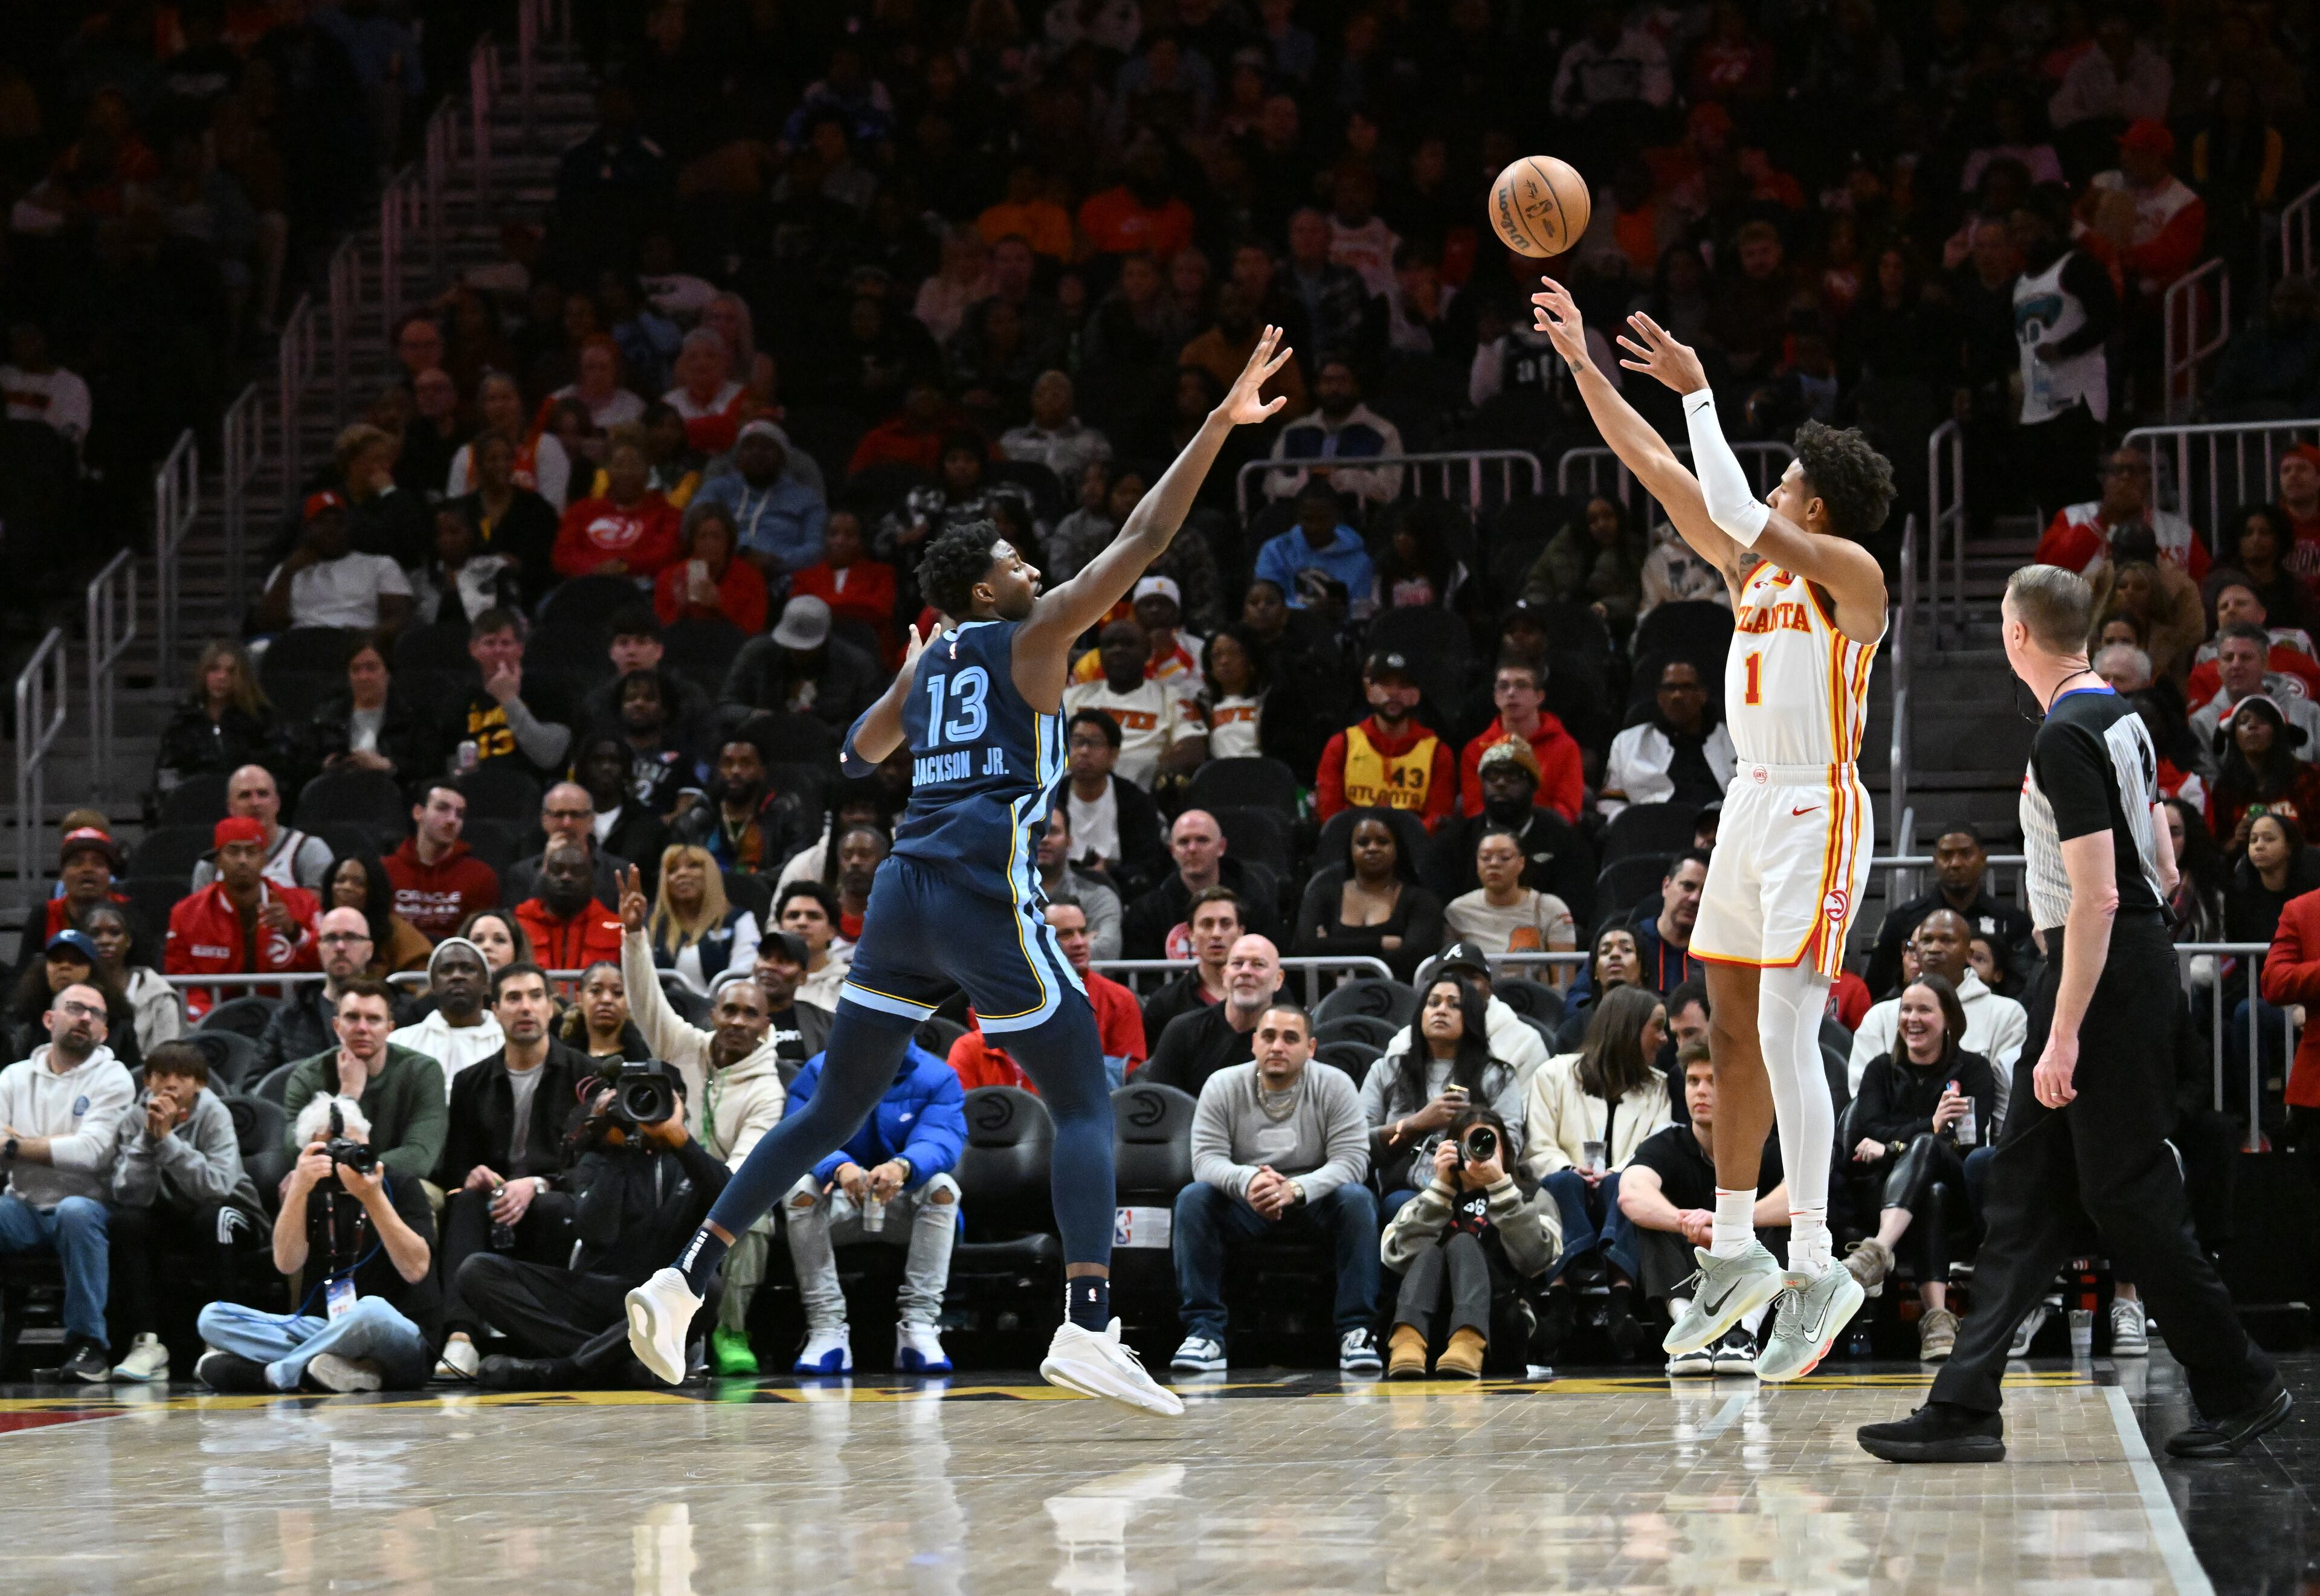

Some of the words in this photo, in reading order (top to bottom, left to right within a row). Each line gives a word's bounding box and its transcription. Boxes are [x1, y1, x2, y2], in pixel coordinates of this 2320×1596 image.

[1745, 651, 1762, 706] 1
[927, 666, 989, 748] 13
[912, 750, 971, 787] JACKSON
[982, 747, 1010, 775] JR.
[1392, 766, 1423, 788] 43
